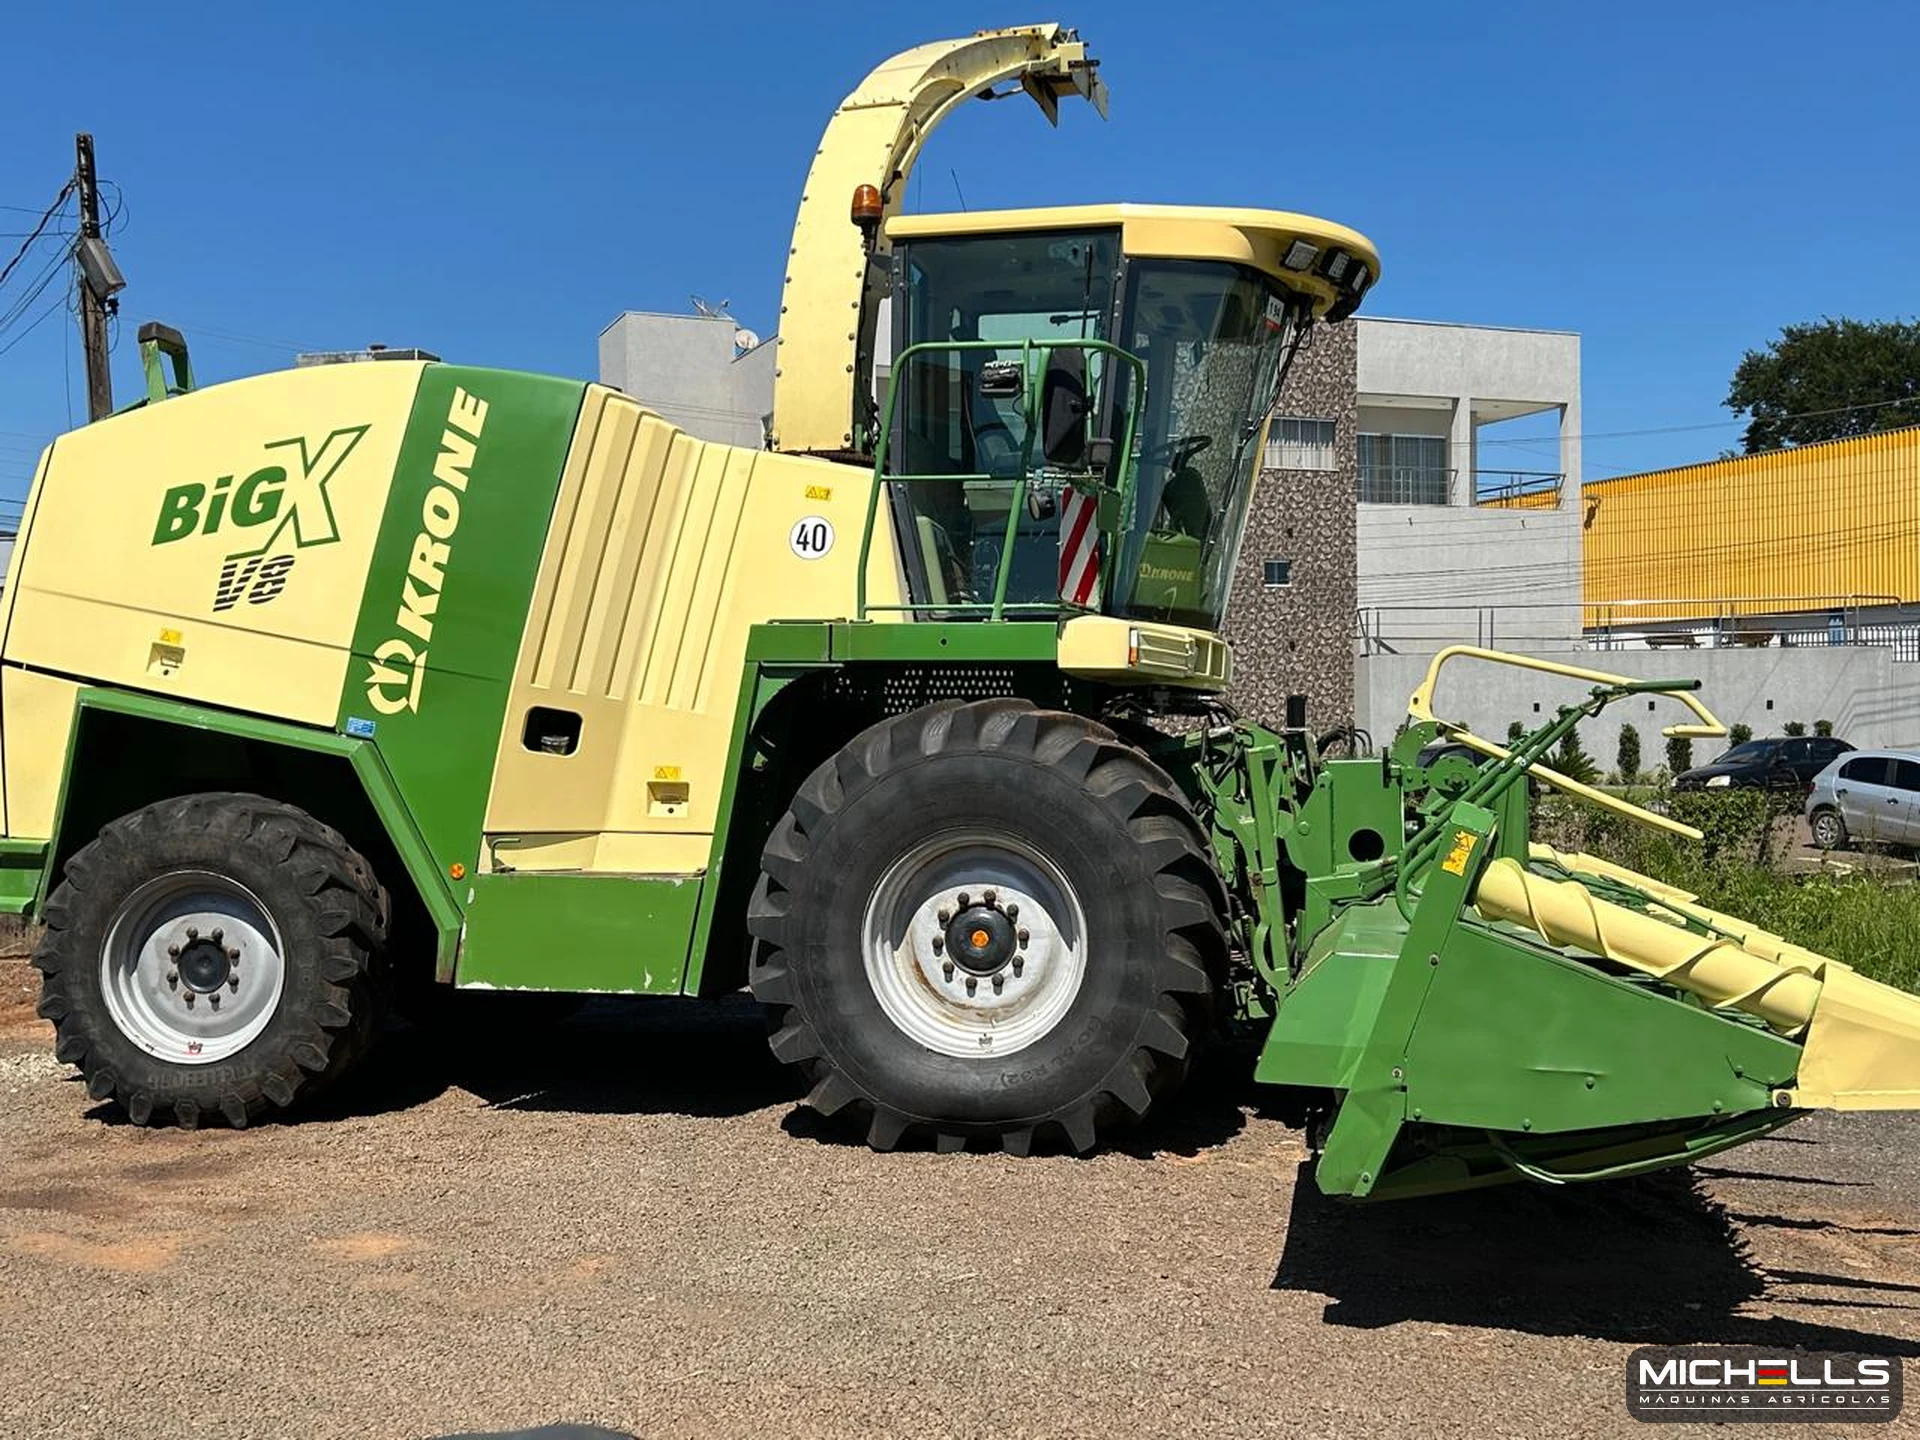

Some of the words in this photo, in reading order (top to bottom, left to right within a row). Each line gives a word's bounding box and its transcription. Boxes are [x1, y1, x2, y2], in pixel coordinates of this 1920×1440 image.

[396, 386, 489, 643] KRONE
[796, 523, 826, 552] 40
[213, 554, 295, 612] V8
[1151, 567, 1194, 582] KRONE
